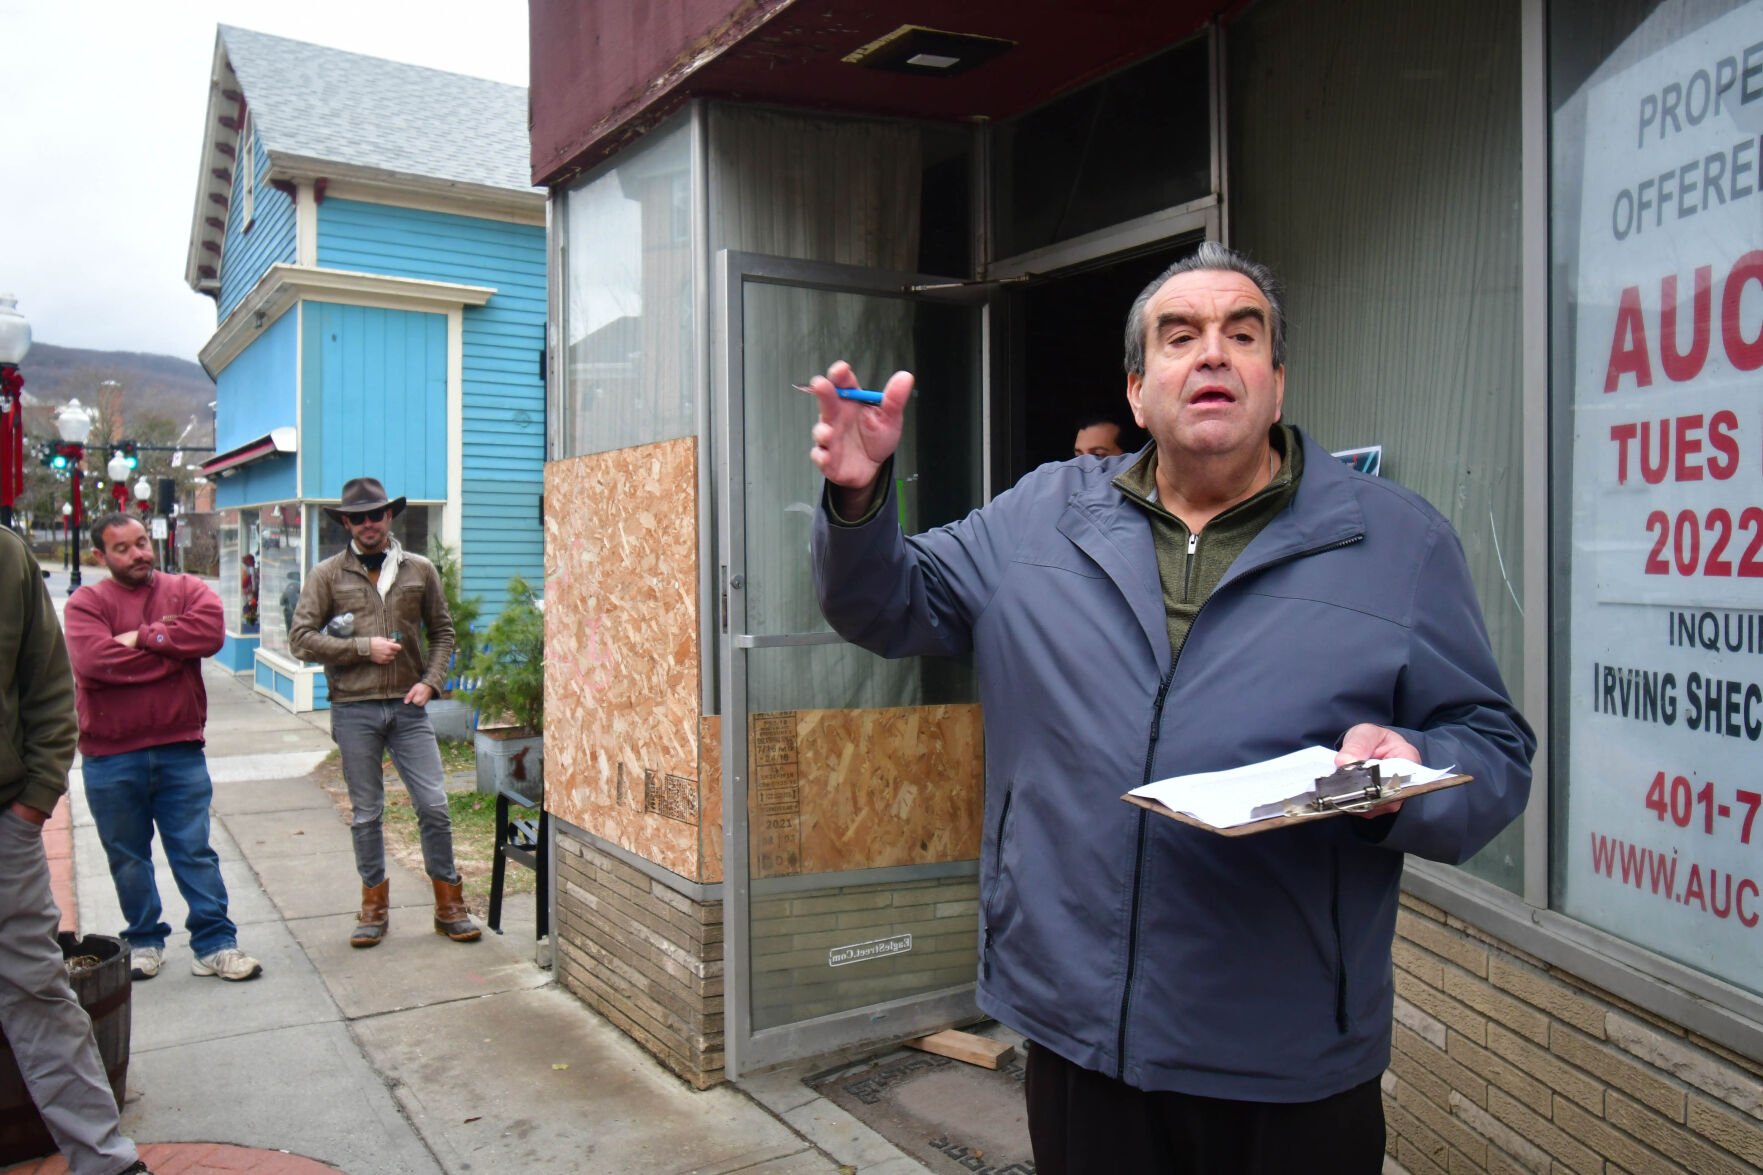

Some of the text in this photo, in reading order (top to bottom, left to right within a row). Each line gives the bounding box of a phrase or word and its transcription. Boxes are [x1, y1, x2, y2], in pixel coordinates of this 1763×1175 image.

[1637, 41, 1763, 149] PROPE
[1612, 134, 1763, 241] OFFERE
[1611, 410, 1740, 486] TUES
[1644, 507, 1763, 578] 2022
[1669, 611, 1763, 655] INQUI
[1594, 662, 1763, 742] IRVING SHEC
[765, 818, 793, 831] 2021
[1645, 771, 1762, 845] 401-7
[1591, 831, 1760, 928] WWW.AUC
